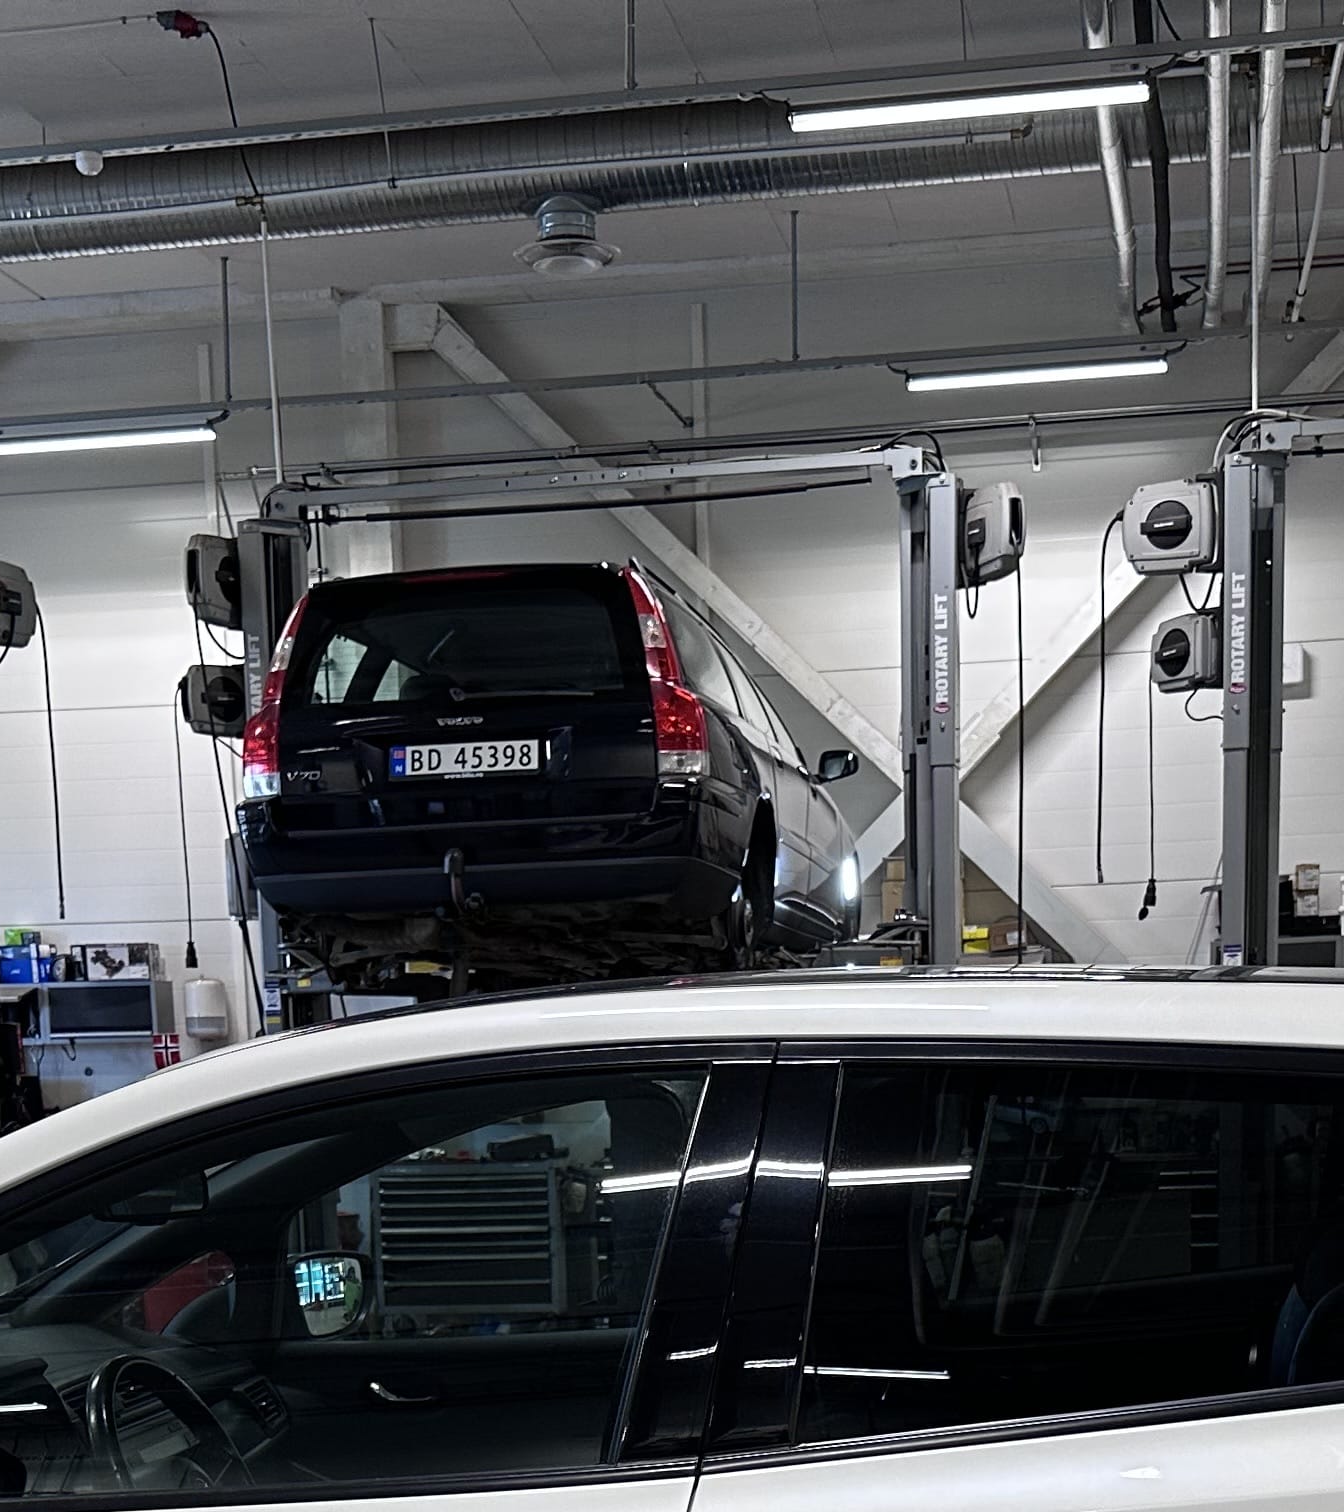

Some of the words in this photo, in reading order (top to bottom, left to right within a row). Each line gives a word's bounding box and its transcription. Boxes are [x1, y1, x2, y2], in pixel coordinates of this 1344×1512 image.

[1231, 572, 1245, 609] LIFT
[934, 594, 948, 630] LIFT
[247, 634, 261, 668] LIFT
[1231, 614, 1245, 684] ROTARY
[934, 635, 949, 703] ROTARY
[411, 750, 442, 772] BD
[454, 744, 532, 770] 45398
